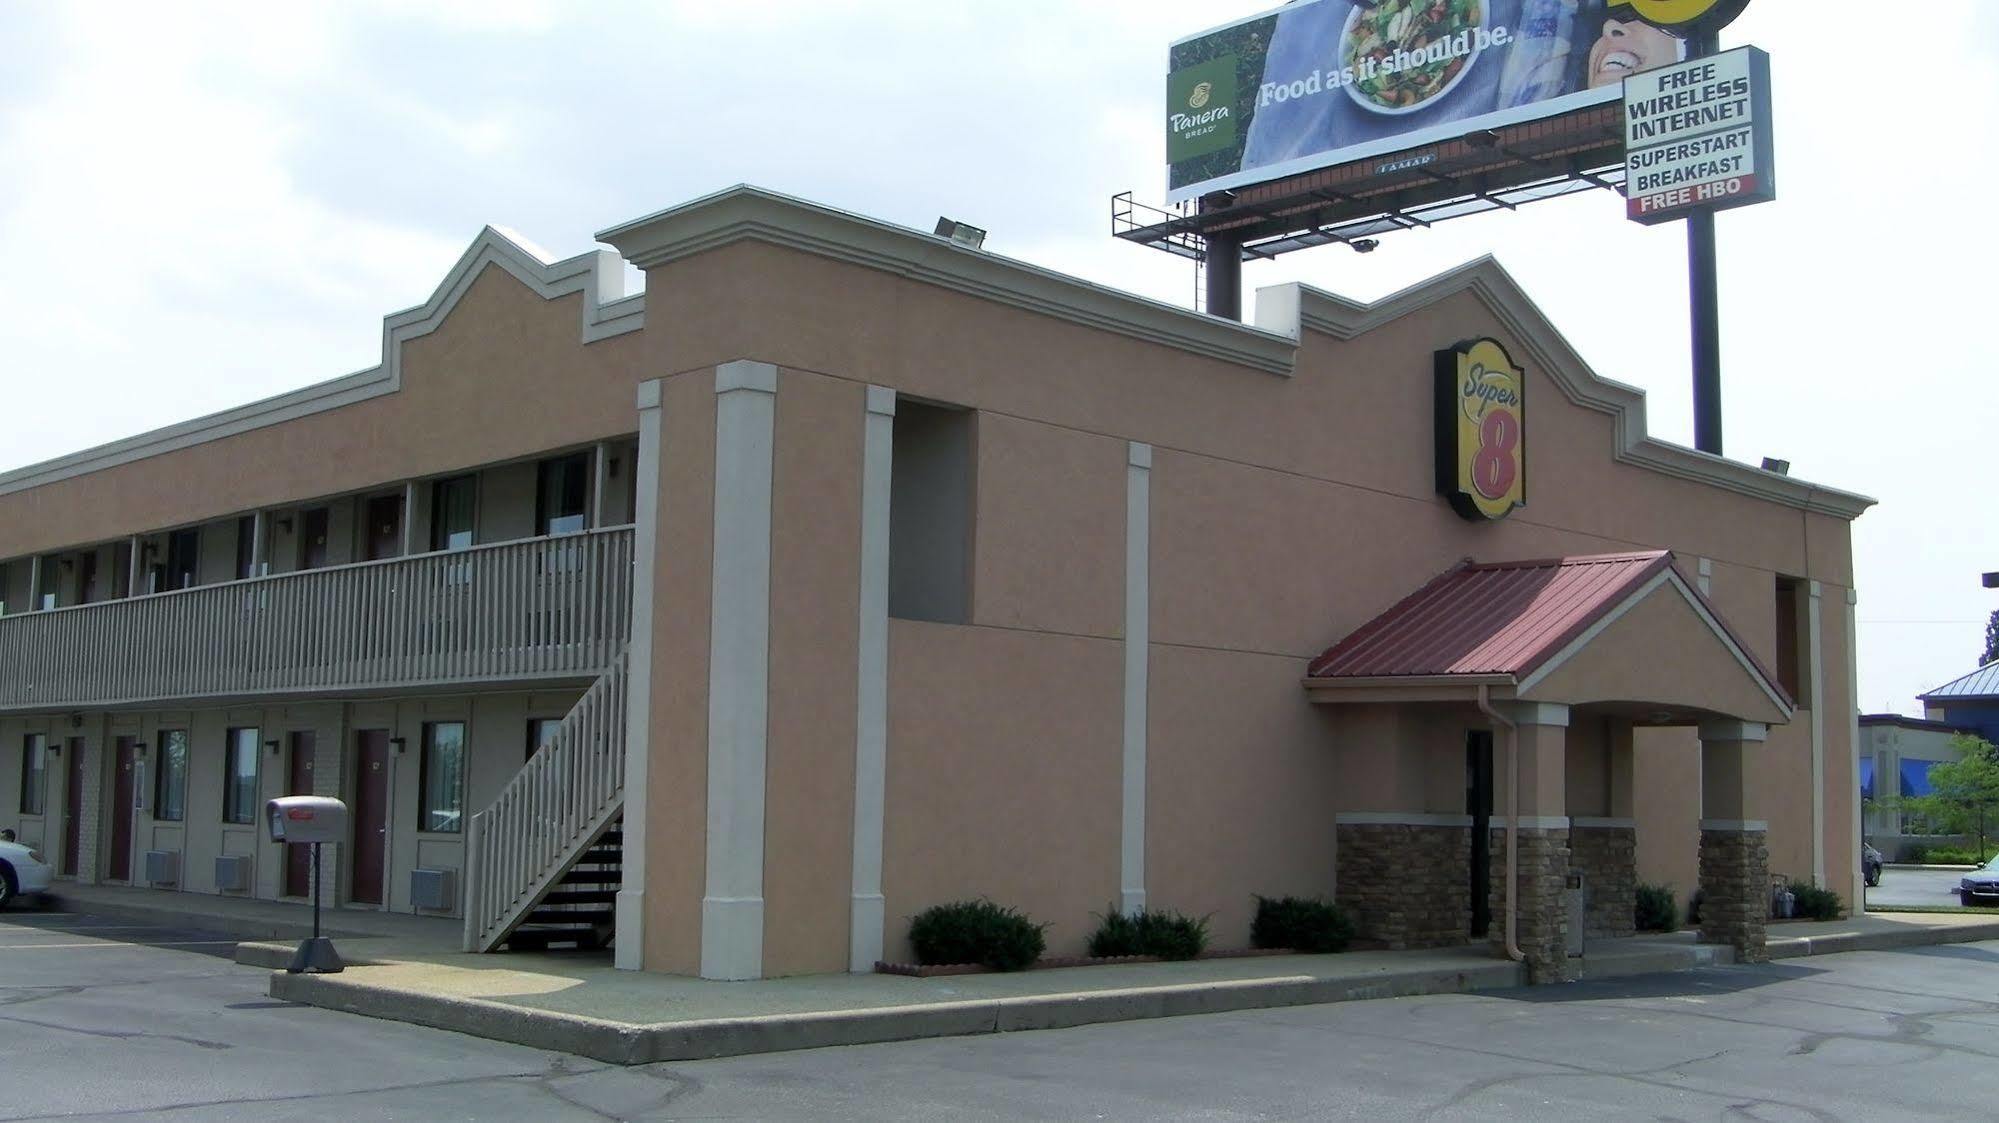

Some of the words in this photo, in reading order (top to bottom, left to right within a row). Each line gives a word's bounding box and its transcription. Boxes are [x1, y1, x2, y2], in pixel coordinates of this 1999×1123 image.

[1260, 69, 1321, 107] Food
[1326, 66, 1354, 90] as
[1358, 56, 1377, 82] it
[1381, 30, 1470, 76] should
[1473, 25, 1513, 51] be.
[1658, 63, 1716, 93] FREE
[1628, 76, 1748, 120] WIRELESS
[1170, 106, 1229, 133] Panera
[1185, 126, 1215, 140] BREAD
[1632, 98, 1748, 141] INTERNET
[1629, 130, 1750, 170] SUPERSTART
[1637, 155, 1743, 192] BREAKFAST
[1640, 188, 1692, 213] FREE
[1697, 178, 1742, 201] HBO
[1463, 362, 1519, 418] Super
[1471, 408, 1519, 500] 8
